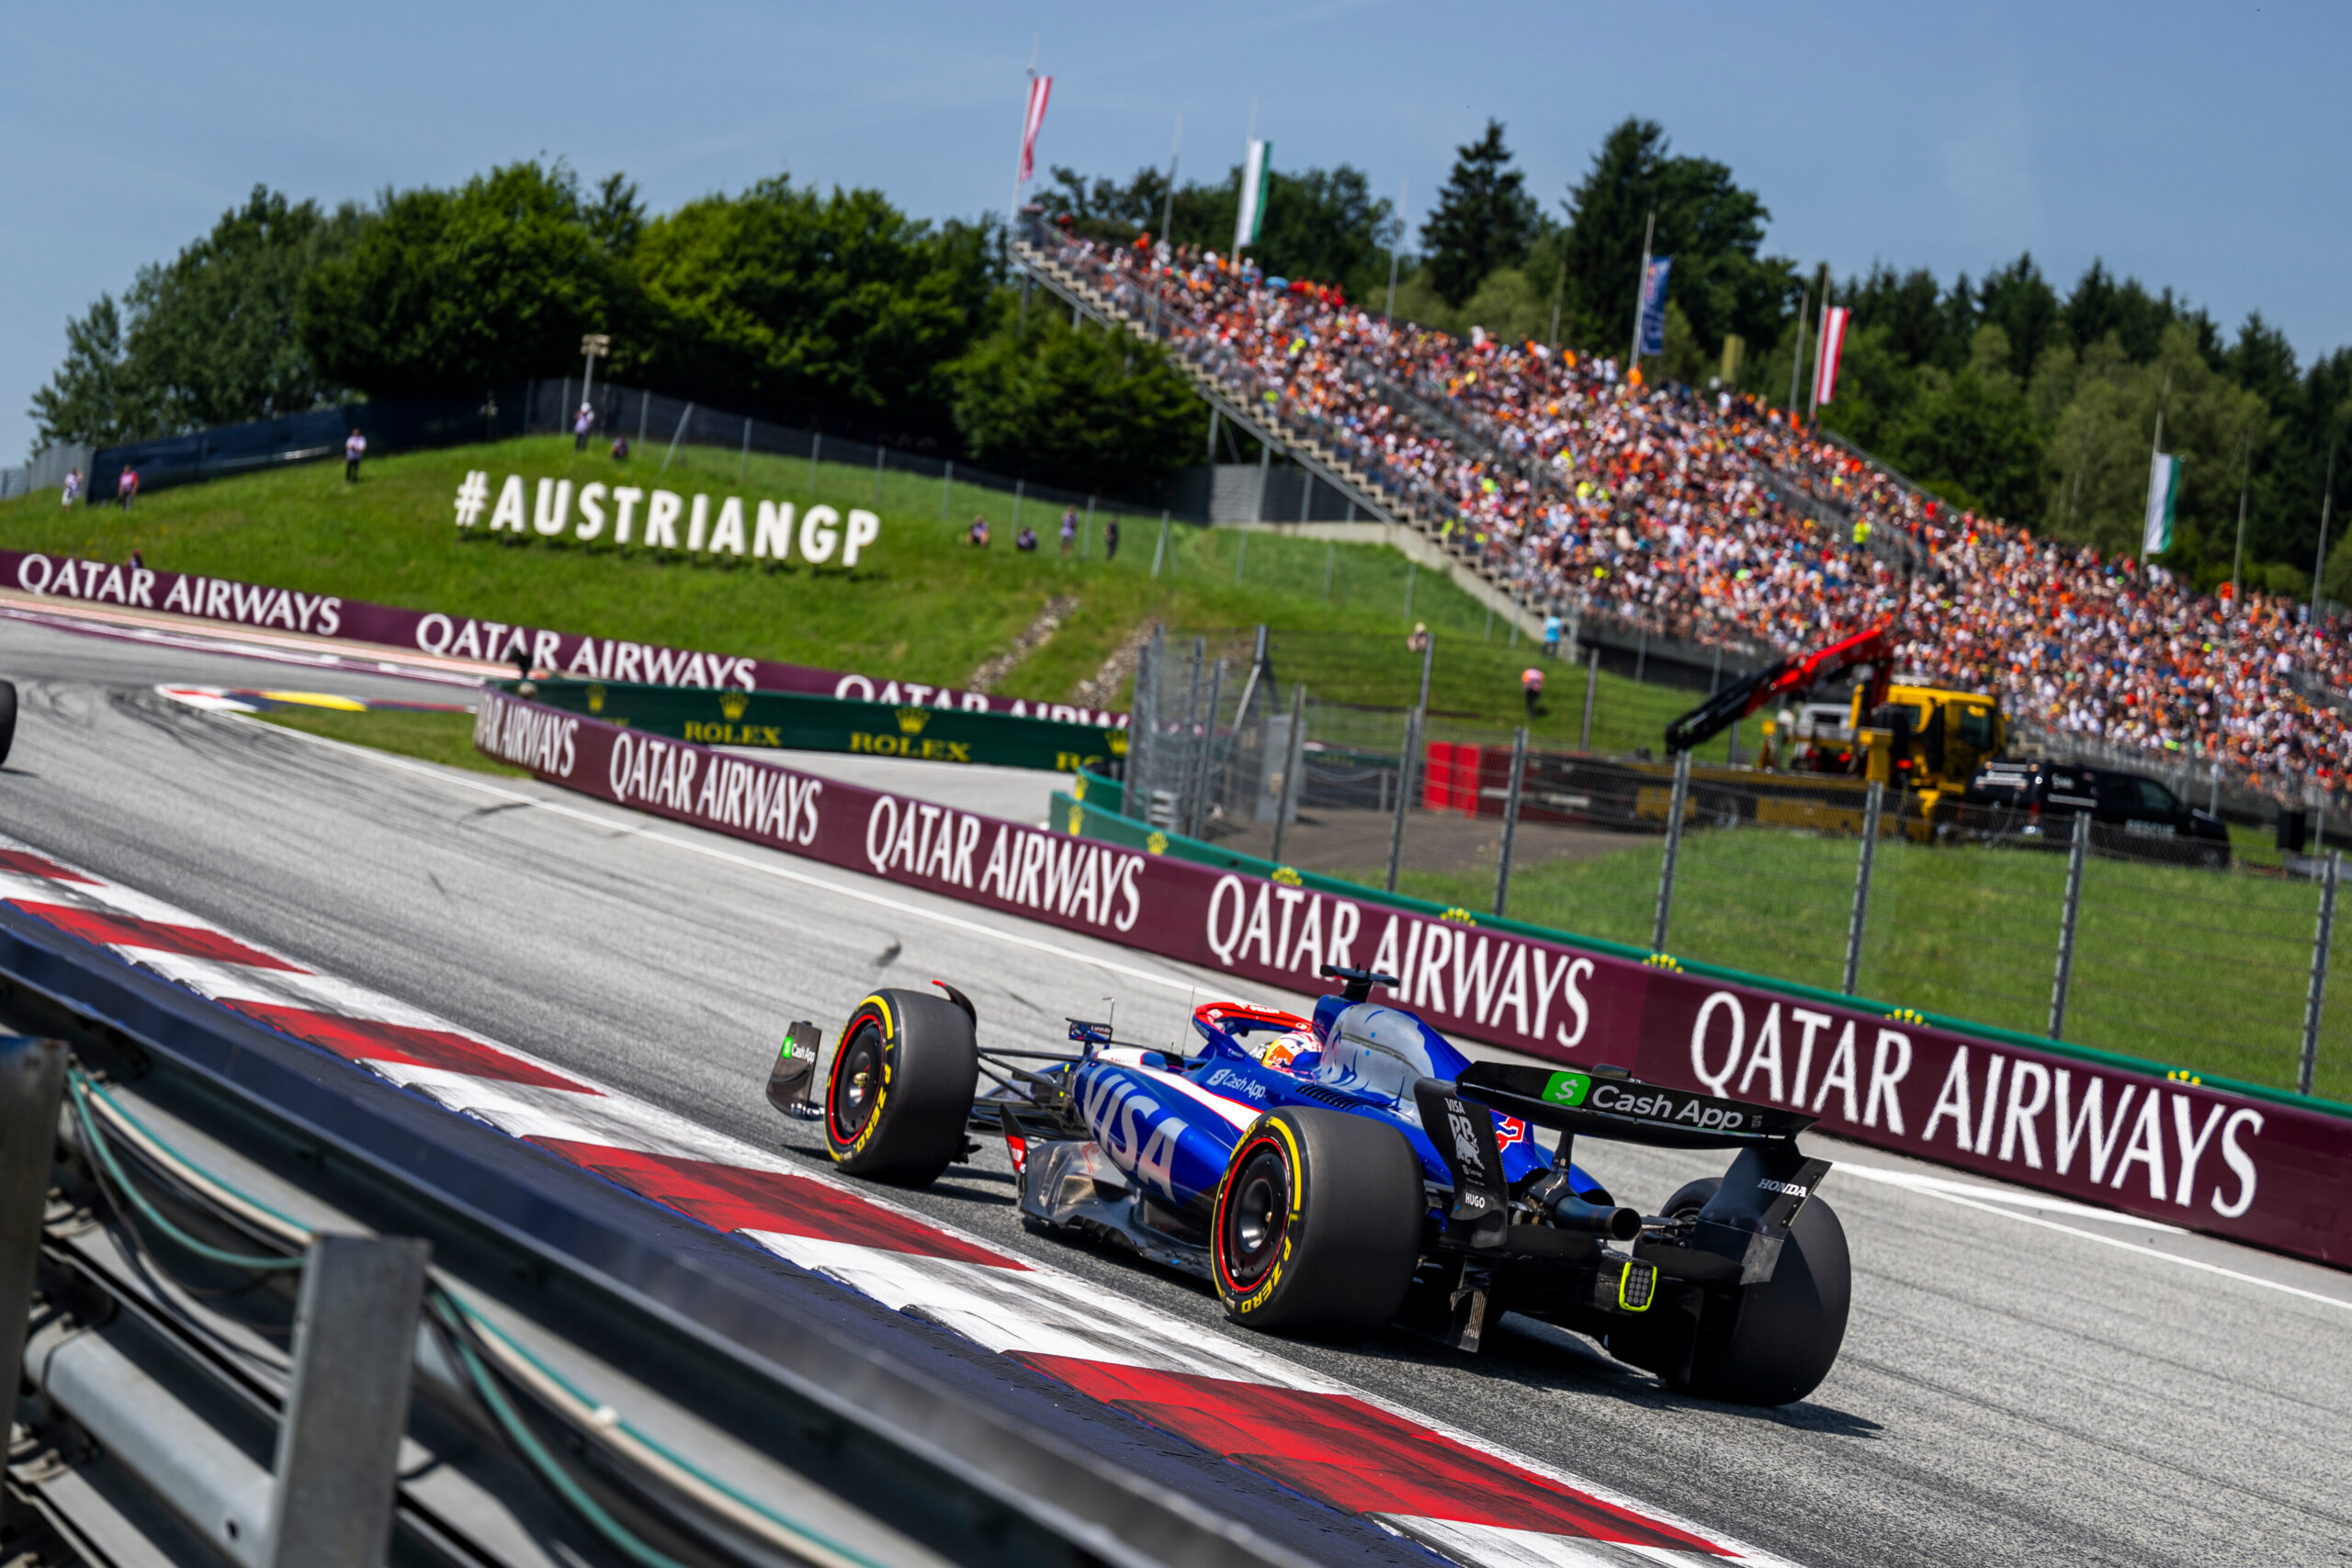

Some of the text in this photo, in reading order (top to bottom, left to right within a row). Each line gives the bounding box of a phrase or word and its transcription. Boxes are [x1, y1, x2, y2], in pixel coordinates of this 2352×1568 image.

[454, 470, 880, 568] #AUSTRIANGP
[17, 553, 342, 636] QATAR AIRWAYS
[416, 613, 757, 693] QATAR AIRWAYS
[498, 702, 580, 778] AIRWAYS
[684, 720, 782, 747] ROLEX
[850, 732, 970, 762] ROLEX
[609, 731, 823, 846] QATAR AIRWAYS
[866, 795, 1146, 932] QATAR AIRWAYS
[1206, 874, 1595, 1048] QATAR AIRWAYS
[791, 1043, 806, 1058] Cash
[804, 1046, 816, 1064] App
[1223, 1072, 1247, 1092] Cash
[1243, 1079, 1266, 1100] App
[856, 1087, 887, 1154] ZERO
[1083, 1064, 1190, 1205] VISA
[1444, 1098, 1465, 1114] VISA
[1592, 1085, 1672, 1117] Cash
[1675, 1100, 1743, 1130] App
[1690, 990, 2266, 1219] QATAR AIRWAYS
[1464, 1191, 1486, 1209] HUGO
[1756, 1178, 1808, 1198] HONDA
[1241, 1261, 1283, 1314] ZERO
